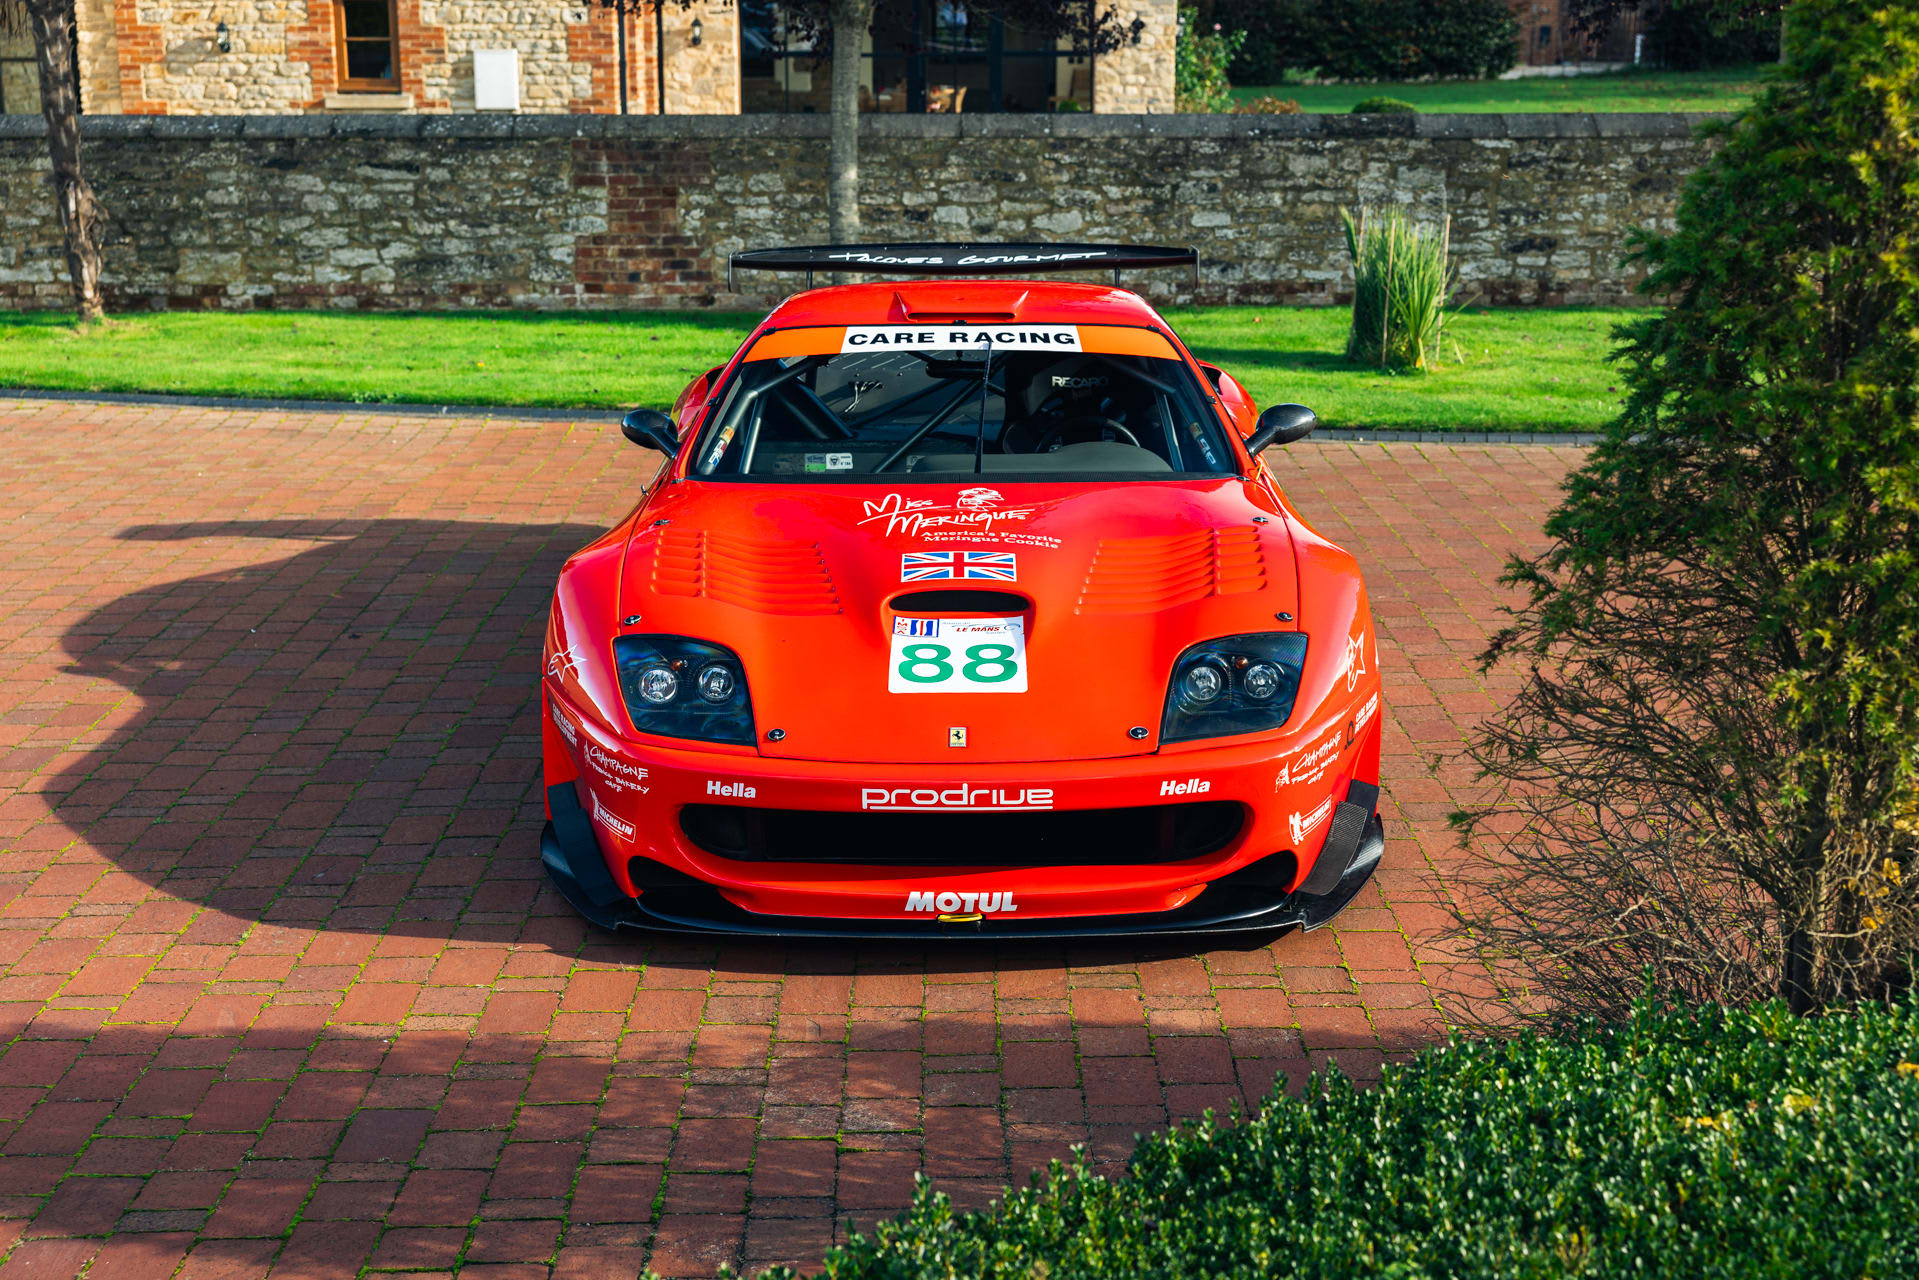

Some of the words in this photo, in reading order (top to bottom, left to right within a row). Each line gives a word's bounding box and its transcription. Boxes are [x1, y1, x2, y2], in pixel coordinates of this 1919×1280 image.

[957, 251, 1107, 264] GOURMET
[849, 332, 935, 345] CARE
[949, 332, 1075, 345] RACING
[1051, 375, 1109, 388] RECARO
[864, 493, 934, 517] Miss
[920, 530, 996, 538] America's
[1001, 532, 1062, 543] Favorite
[1004, 537, 1059, 549] Cookie
[898, 643, 1019, 684] 88
[589, 745, 649, 780] CHAMPAGNE
[614, 776, 650, 795] BAKERY
[706, 780, 757, 799] Hella
[1160, 778, 1211, 797] Hella
[599, 807, 634, 836] MICHELIN
[904, 891, 1018, 912] MOTUL
